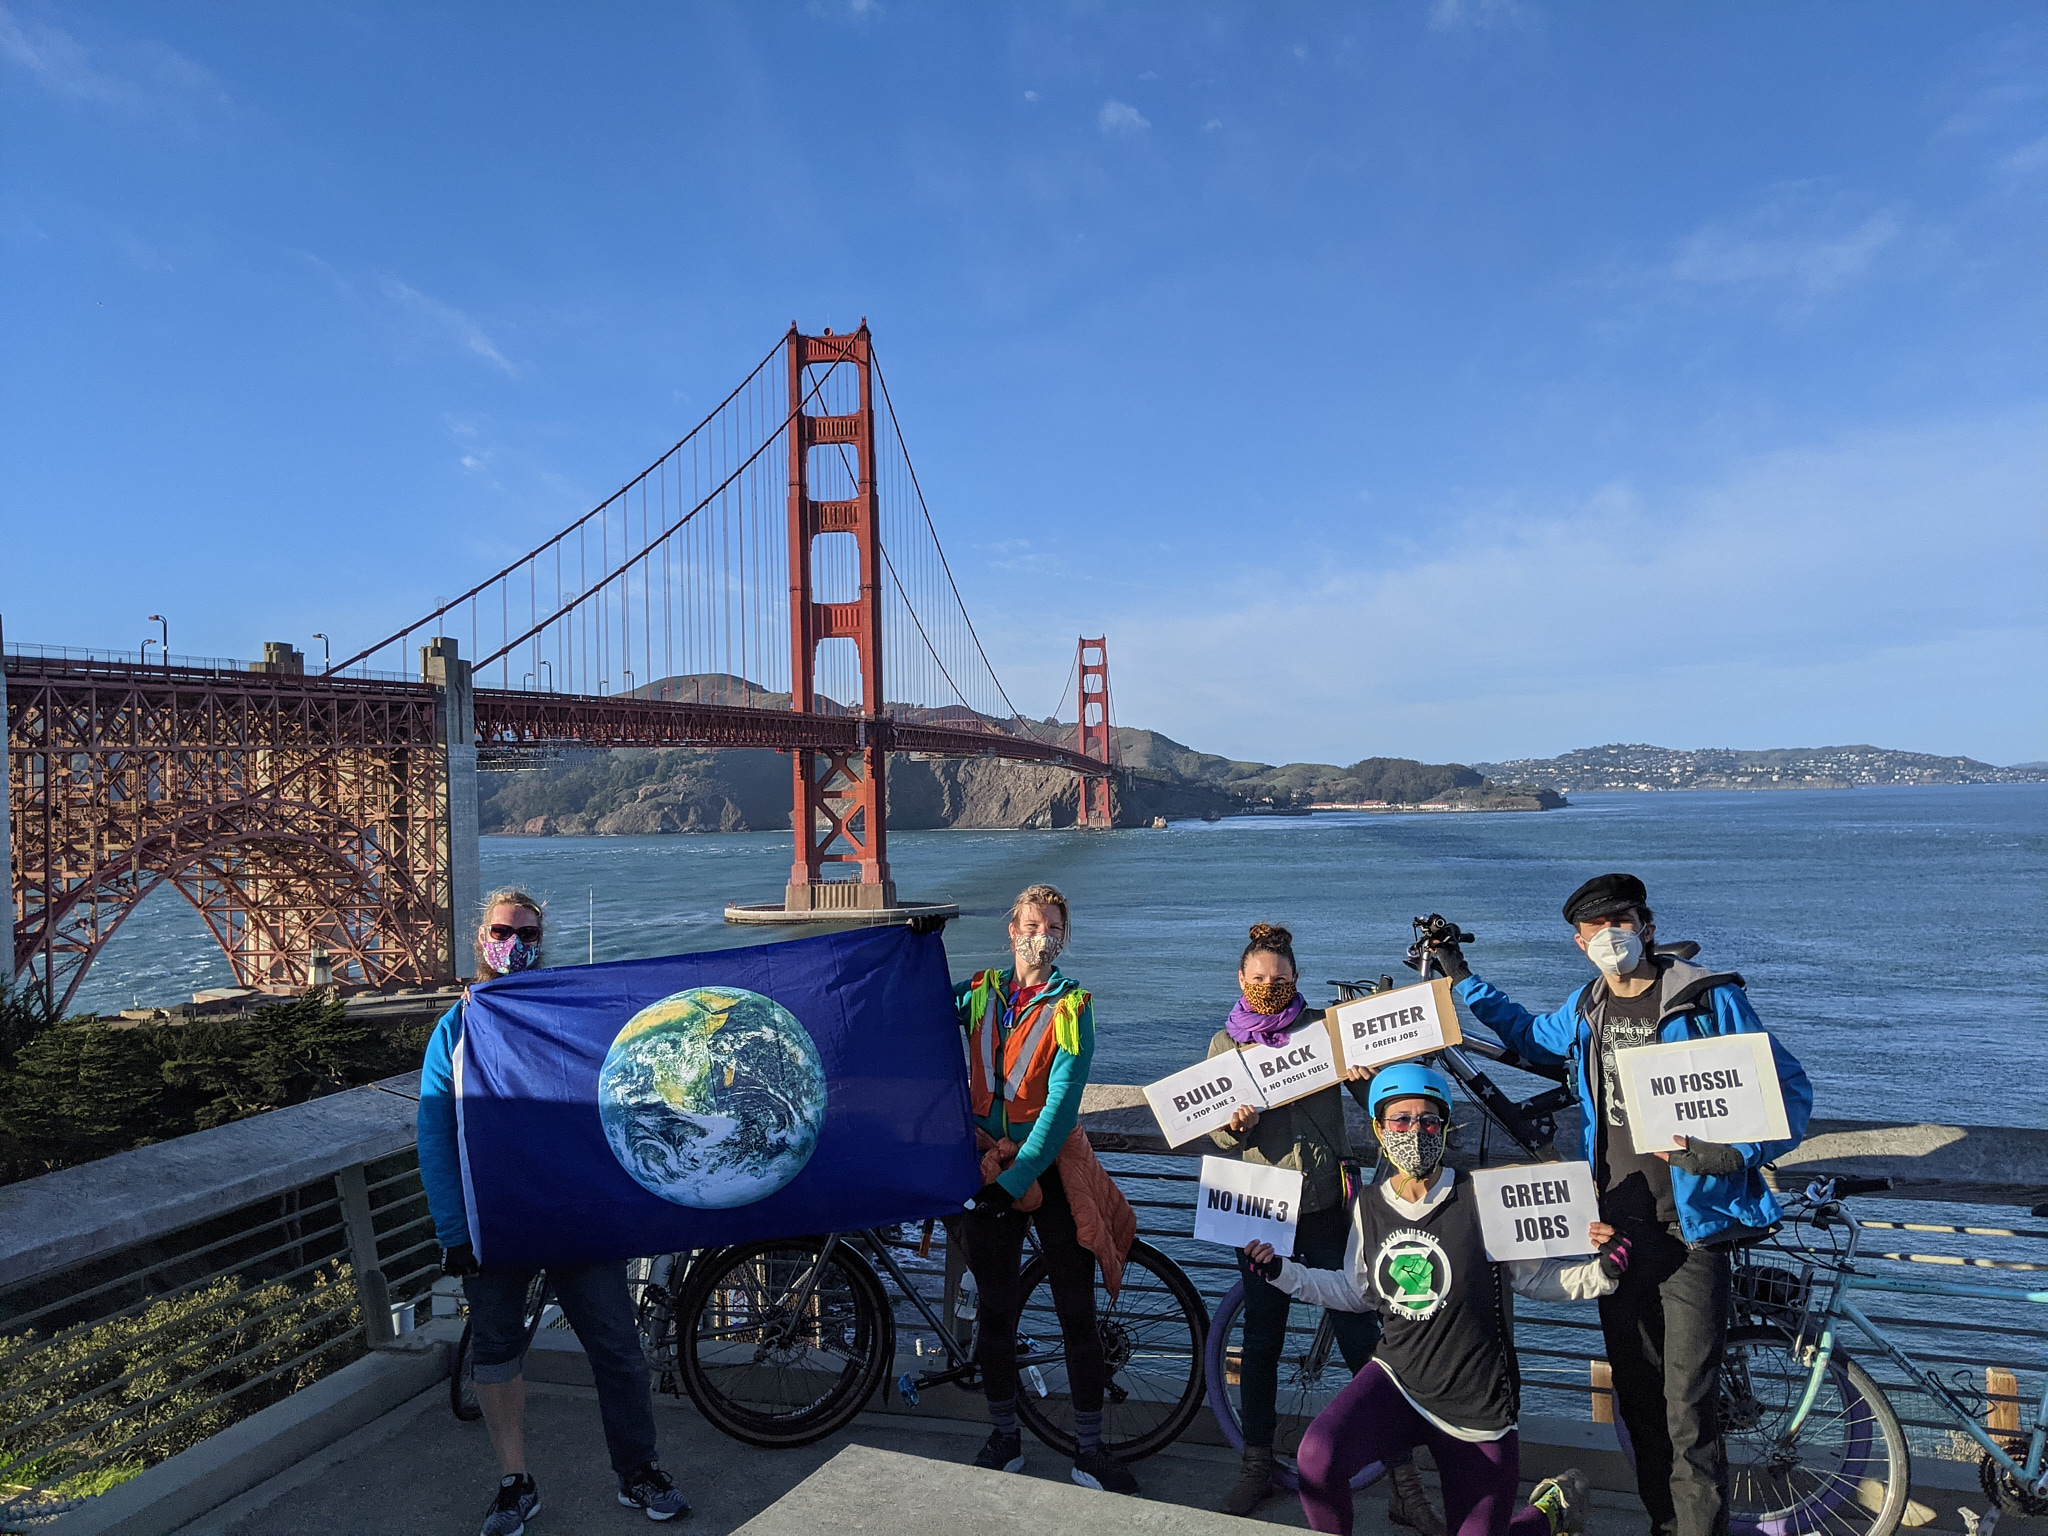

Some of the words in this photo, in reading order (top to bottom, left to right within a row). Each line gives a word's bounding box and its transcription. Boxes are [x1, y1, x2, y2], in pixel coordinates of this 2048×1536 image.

[1352, 1006, 1426, 1039] BETTER
[1611, 1025, 1634, 1034] rise
[1372, 1036, 1397, 1049] GREEN
[1399, 1030, 1419, 1042] JOBS
[1259, 1044, 1317, 1078] BACK
[1269, 1081, 1281, 1091] NO
[1282, 1071, 1307, 1085] FOSSIL
[1308, 1062, 1329, 1075] FUELS
[1650, 1076, 1677, 1096] NO
[1679, 1069, 1743, 1093] FOSSIL
[1173, 1077, 1233, 1112] BUILD
[1193, 1107, 1211, 1119] STOP
[1212, 1099, 1229, 1110] LINE
[1674, 1098, 1729, 1121] FUELS
[1207, 1188, 1233, 1212] NO
[1236, 1193, 1274, 1220] LINE
[1276, 1200, 1289, 1222] 3
[1501, 1180, 1571, 1209] GREEN
[1381, 1229, 1404, 1249] RACIAL
[1405, 1228, 1440, 1244] JUSTICE
[1514, 1214, 1570, 1242] JOBS
